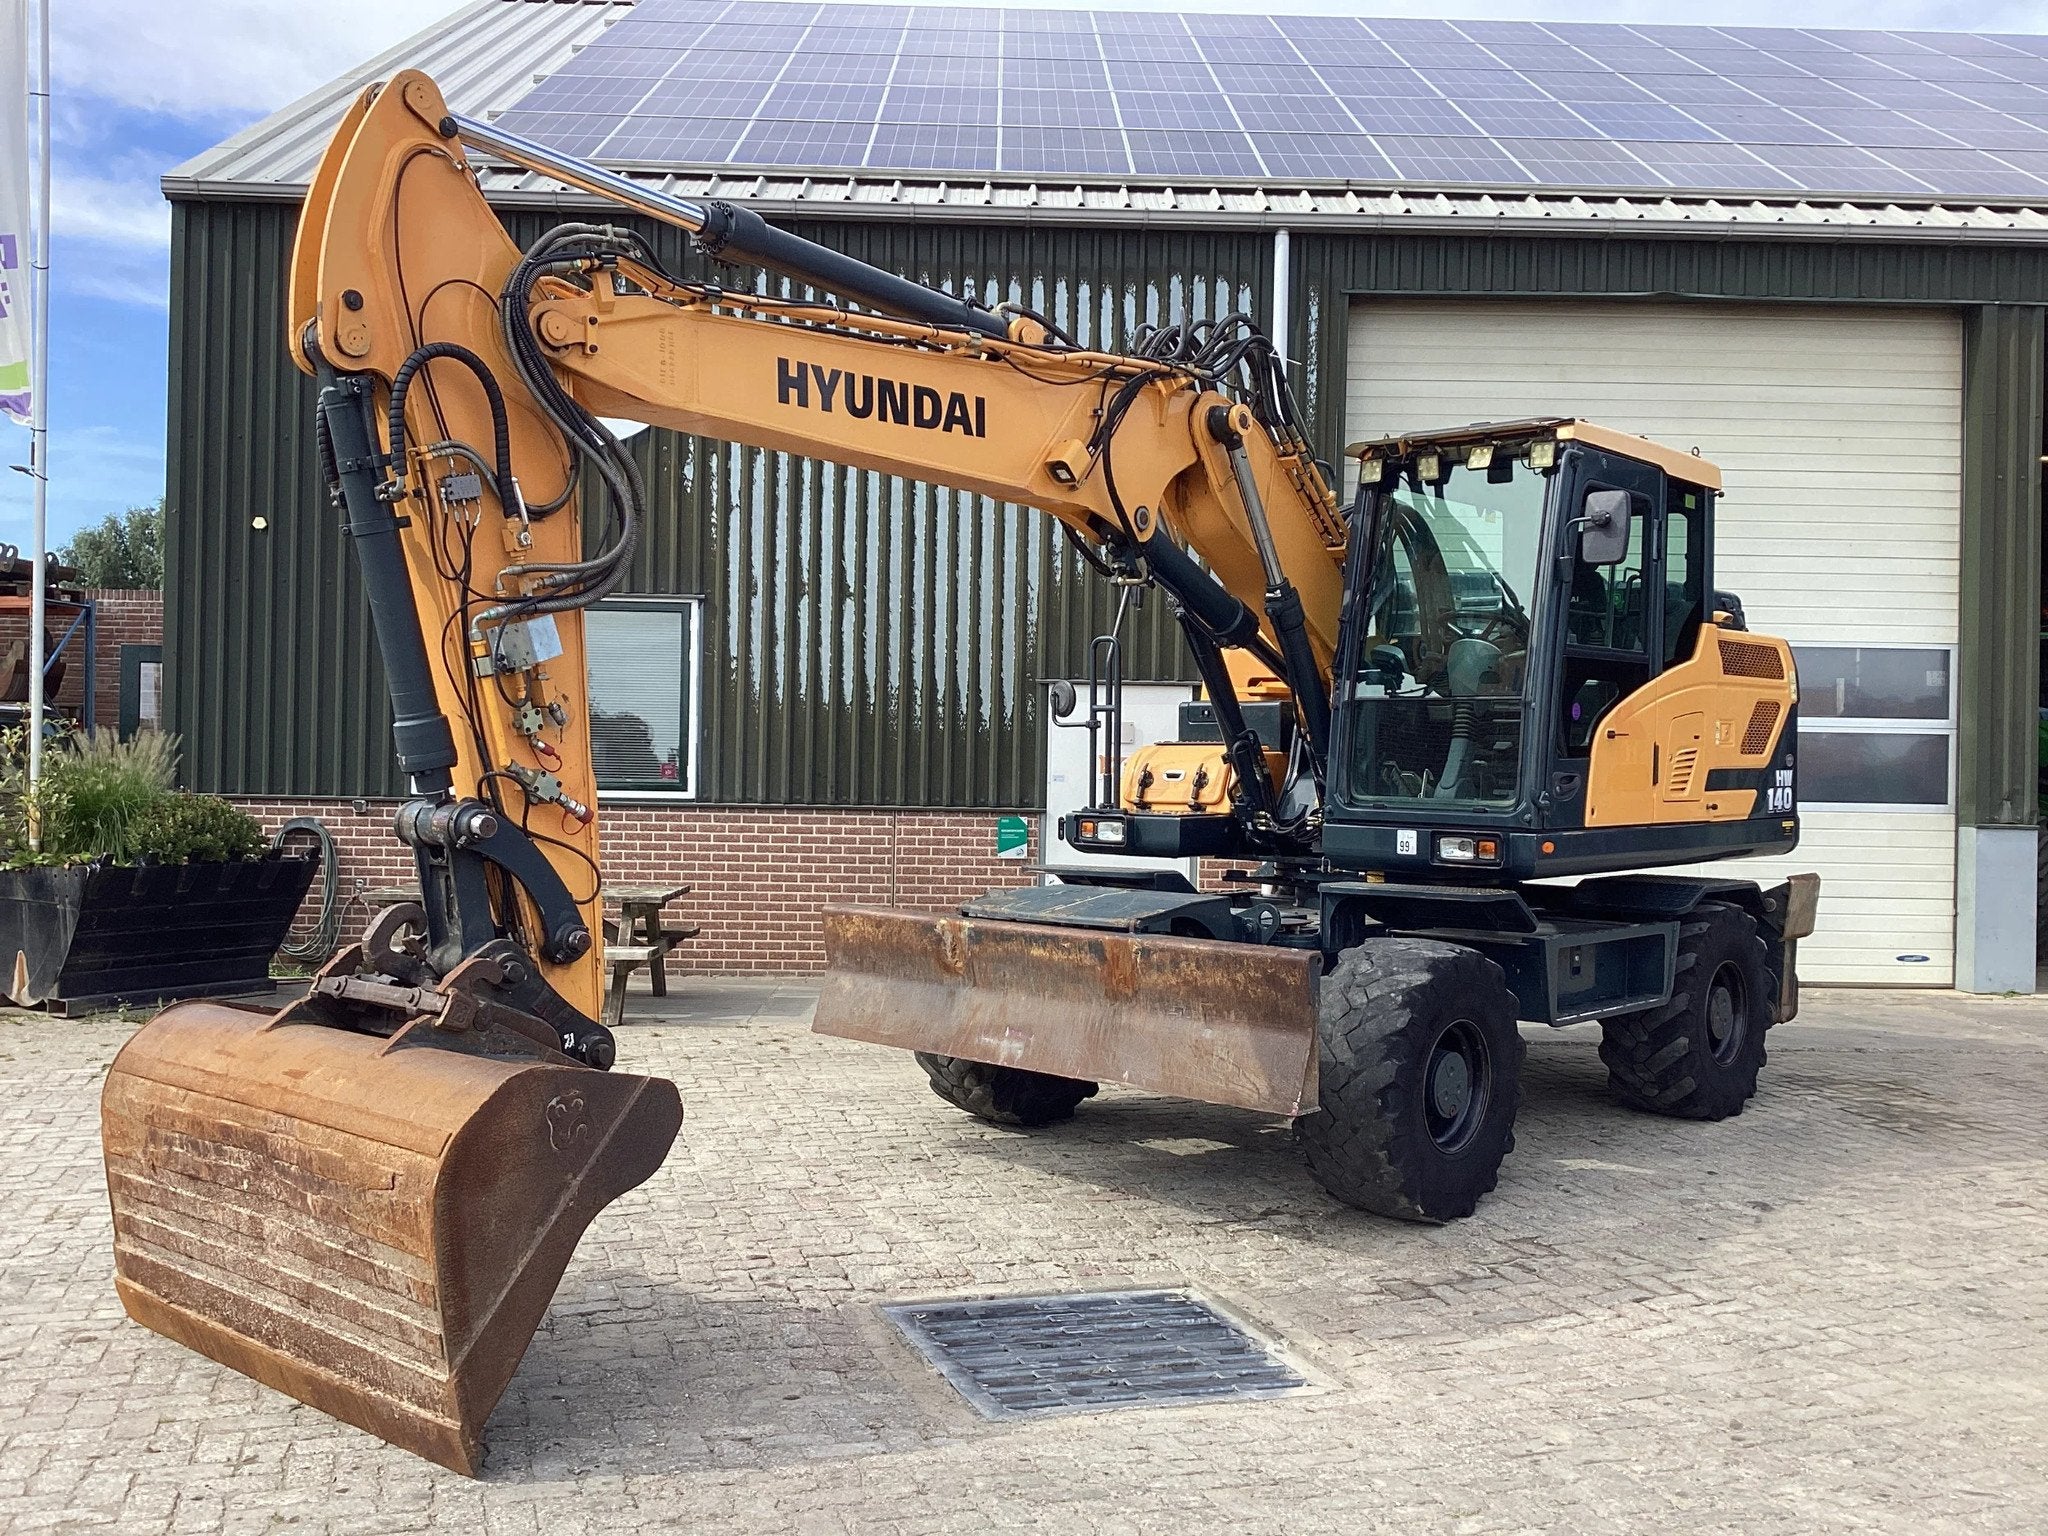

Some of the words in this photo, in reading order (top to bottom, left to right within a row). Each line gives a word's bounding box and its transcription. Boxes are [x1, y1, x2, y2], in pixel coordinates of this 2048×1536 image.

[777, 357, 986, 438] HYUNDAI
[1775, 769, 1793, 787] HW
[1767, 787, 1792, 812] 140
